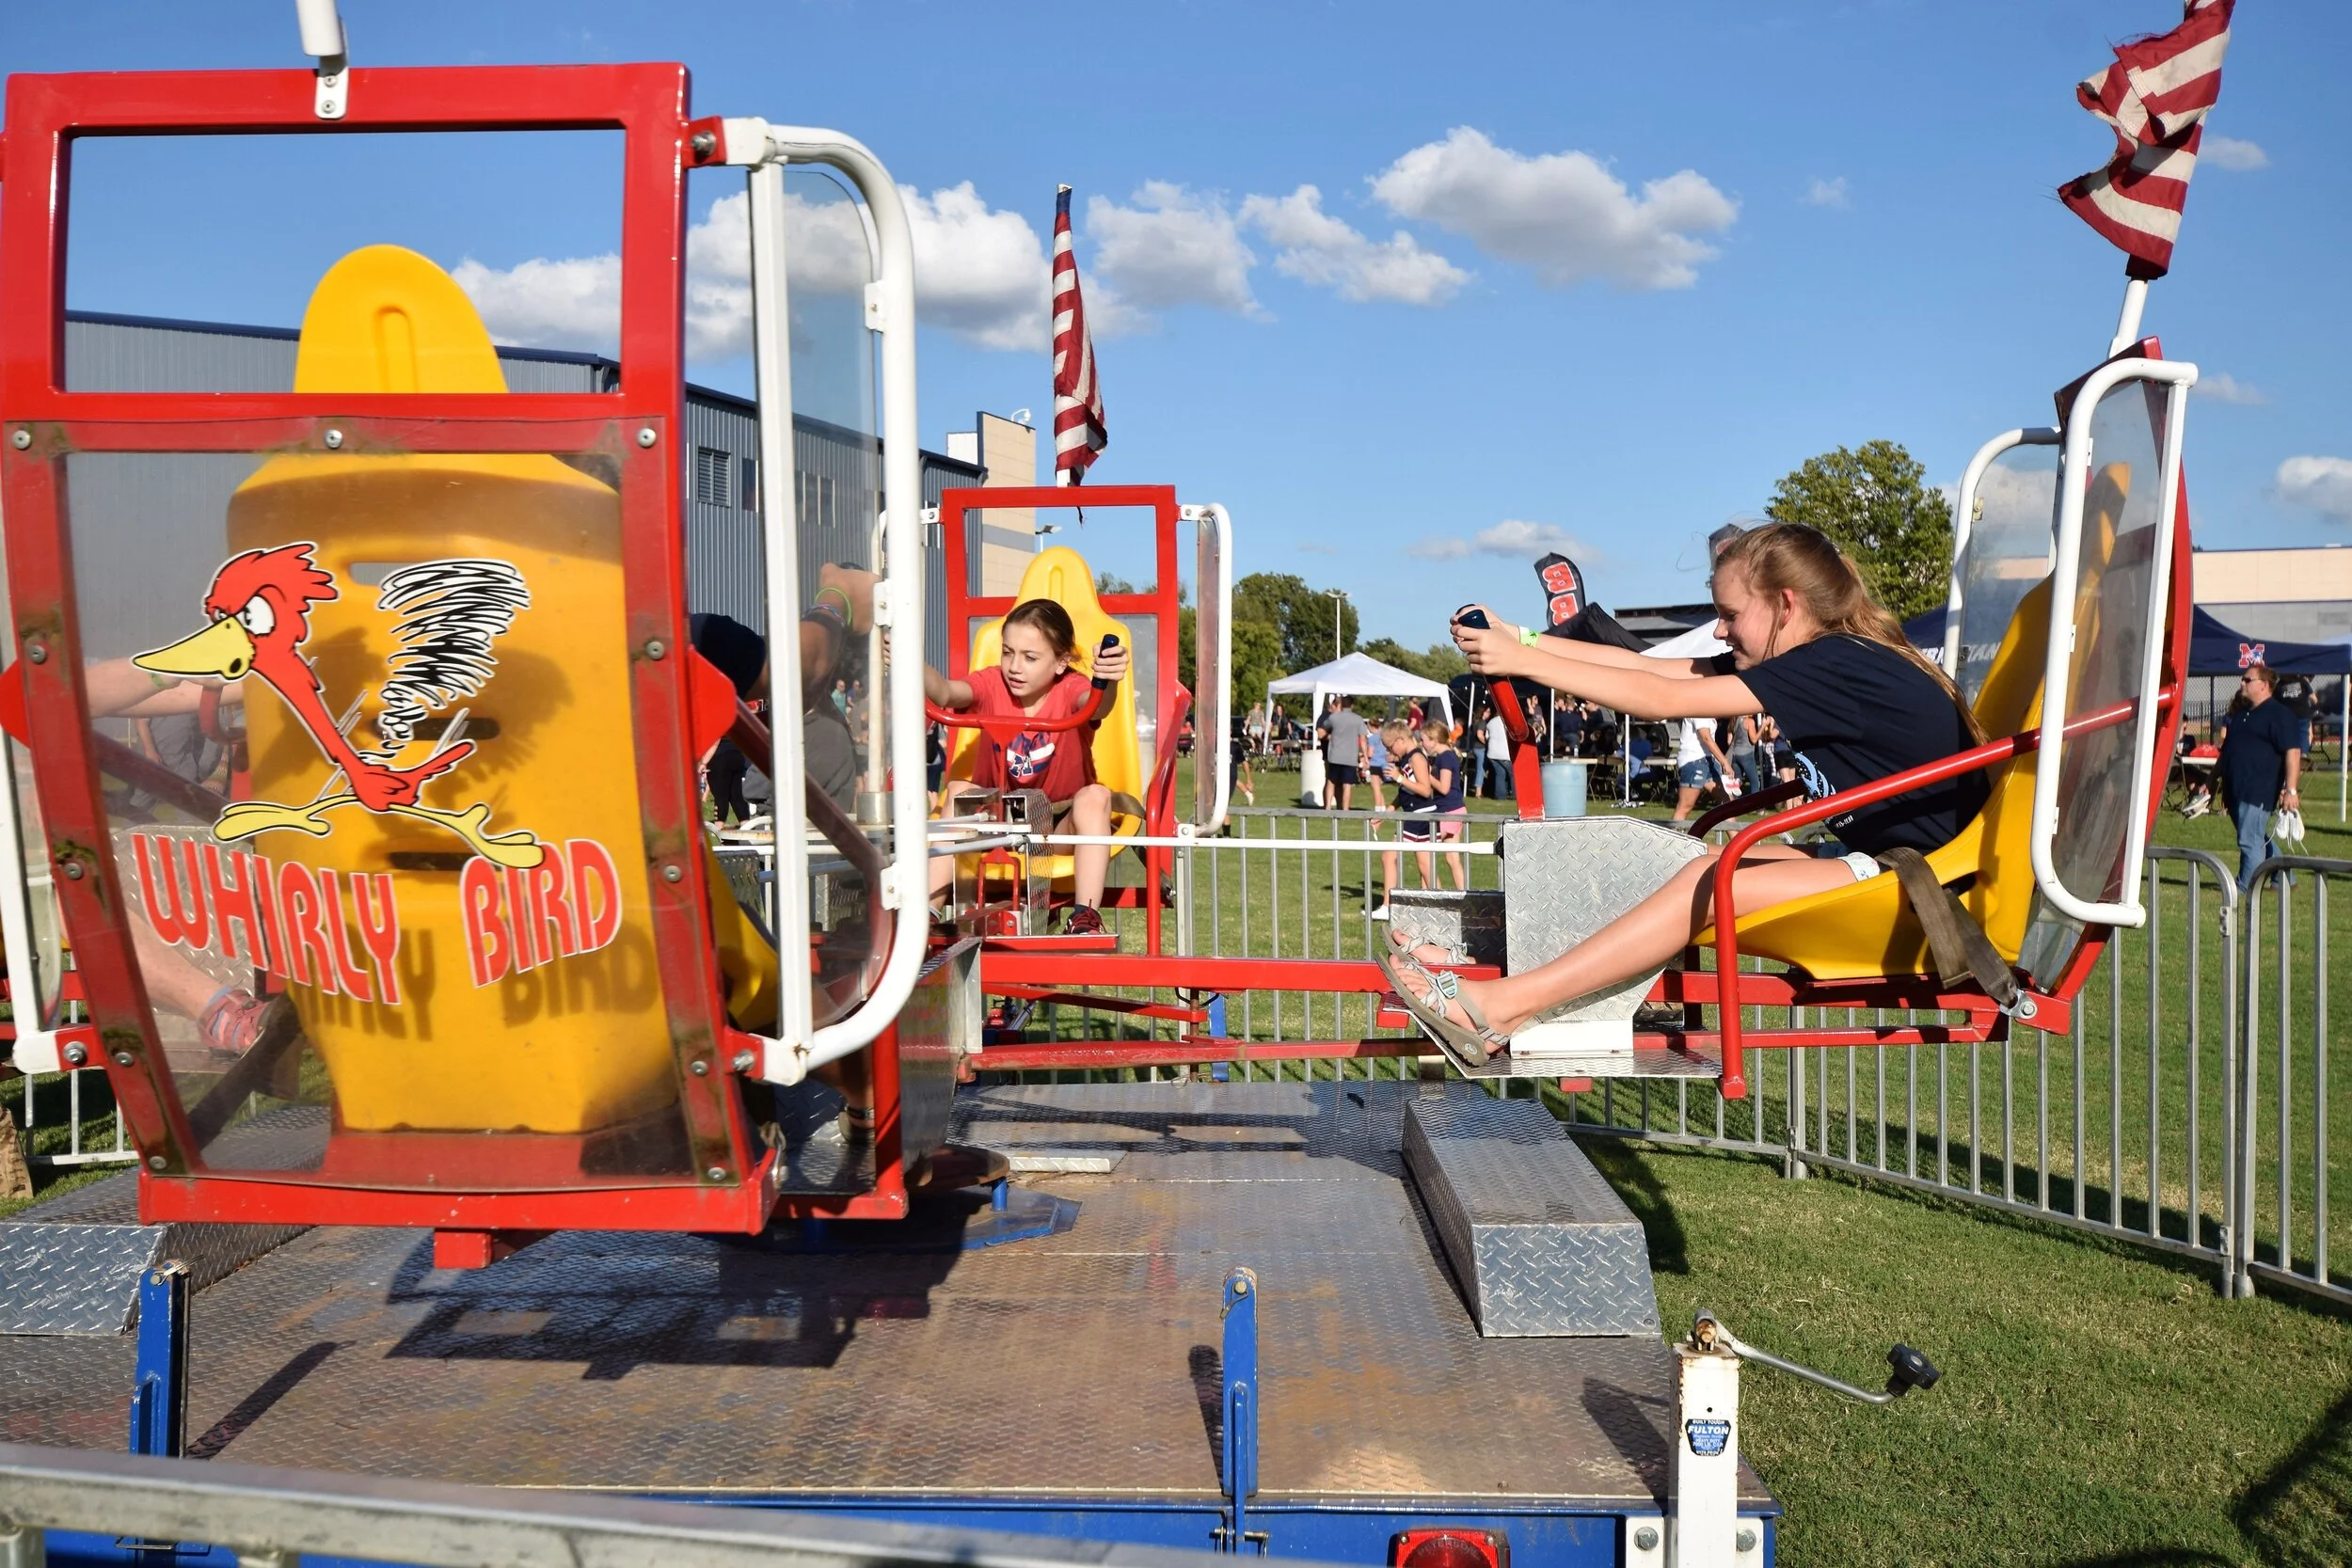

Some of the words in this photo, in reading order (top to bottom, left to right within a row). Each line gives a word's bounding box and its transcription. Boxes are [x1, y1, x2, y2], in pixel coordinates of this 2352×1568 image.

[132, 832, 401, 1005] WHIRLY
[460, 838, 622, 989] BIRD
[1688, 1425, 1729, 1434] FULTON
